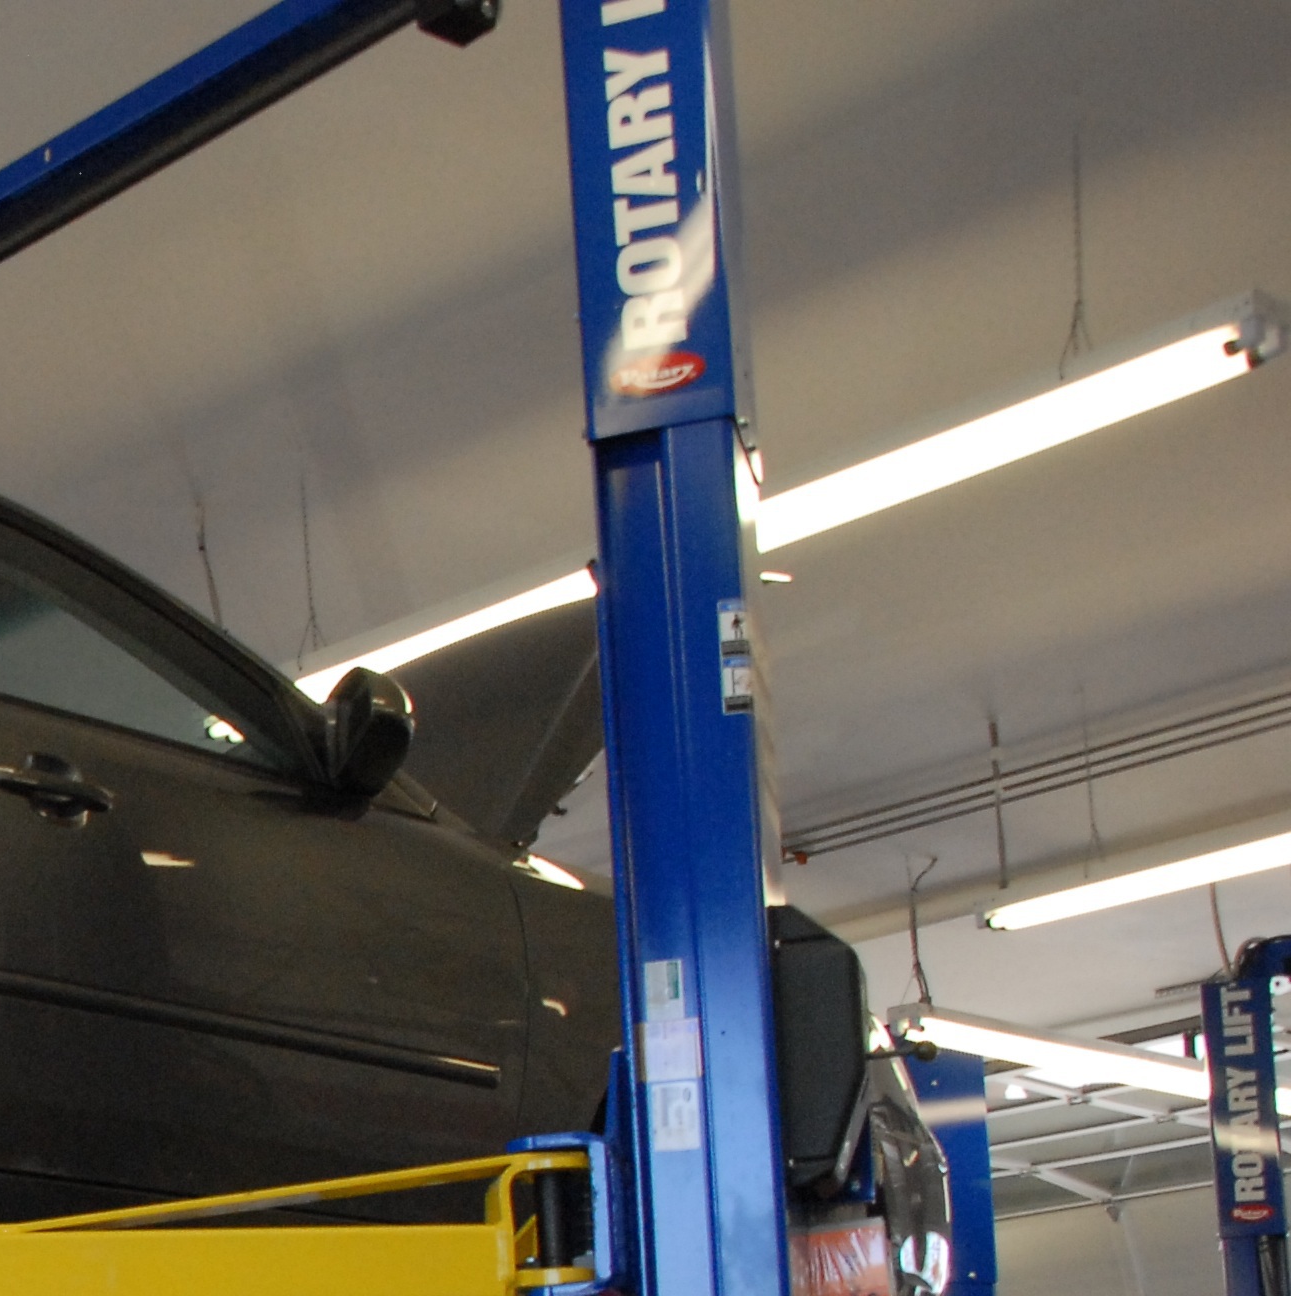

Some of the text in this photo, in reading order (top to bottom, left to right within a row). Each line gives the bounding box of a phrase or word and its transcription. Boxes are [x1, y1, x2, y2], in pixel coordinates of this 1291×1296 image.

[602, 48, 688, 351] ROTARY
[1221, 985, 1267, 1203] ROTARY LIFT
